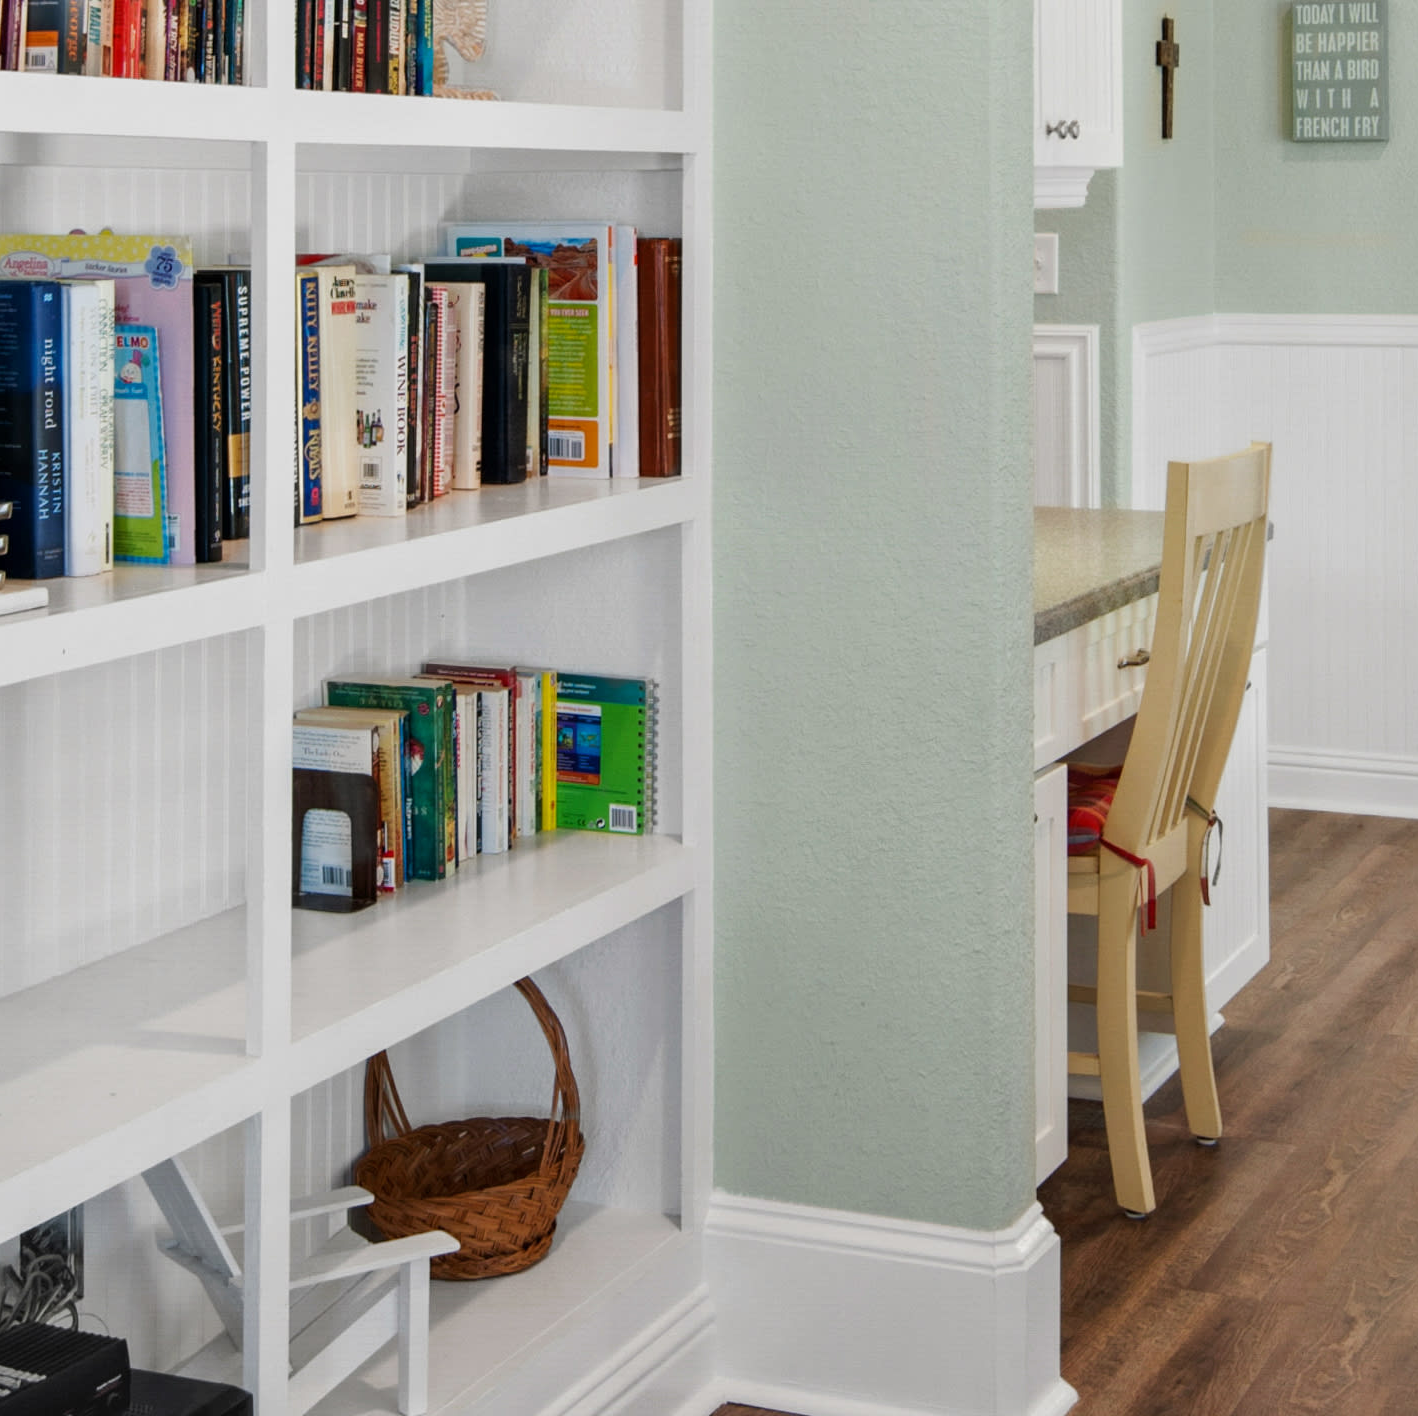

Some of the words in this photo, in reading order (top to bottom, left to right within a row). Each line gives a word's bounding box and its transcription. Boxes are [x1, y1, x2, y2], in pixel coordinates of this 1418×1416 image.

[89, 6, 102, 46] MARY
[389, 10, 400, 55] LUDLUM
[1296, 3, 1335, 25] TODAY
[1339, 3, 1344, 24] I
[1349, 2, 1379, 24] WILL
[356, 32, 365, 54] MAD
[1296, 32, 1313, 54] BE
[1318, 31, 1379, 53] HAPPIER
[355, 58, 365, 88] RIVER
[1296, 59, 1330, 81] THAN
[1334, 59, 1343, 81] A
[1347, 58, 1379, 81] BIRD
[1296, 88, 1351, 109] WITH
[1370, 87, 1379, 108] A
[1296, 117, 1350, 138] FRENCH
[1355, 116, 1379, 137] FRY
[3, 257, 48, 274] Angelina
[156, 256, 173, 272] 75
[210, 300, 222, 351] WEIRD
[238, 286, 249, 360] SUPREME
[306, 282, 317, 328] KITTY
[41, 338, 56, 383] night
[117, 336, 148, 348] ELMO
[307, 335, 318, 392] KELLEY
[396, 354, 406, 403] WINE
[43, 390, 57, 430] road
[211, 355, 222, 433] KENTUCKY
[239, 366, 250, 422] POWER
[396, 406, 406, 456] BOOK
[38, 449, 49, 520] HANNAH
[51, 452, 62, 514] KRISTIN
